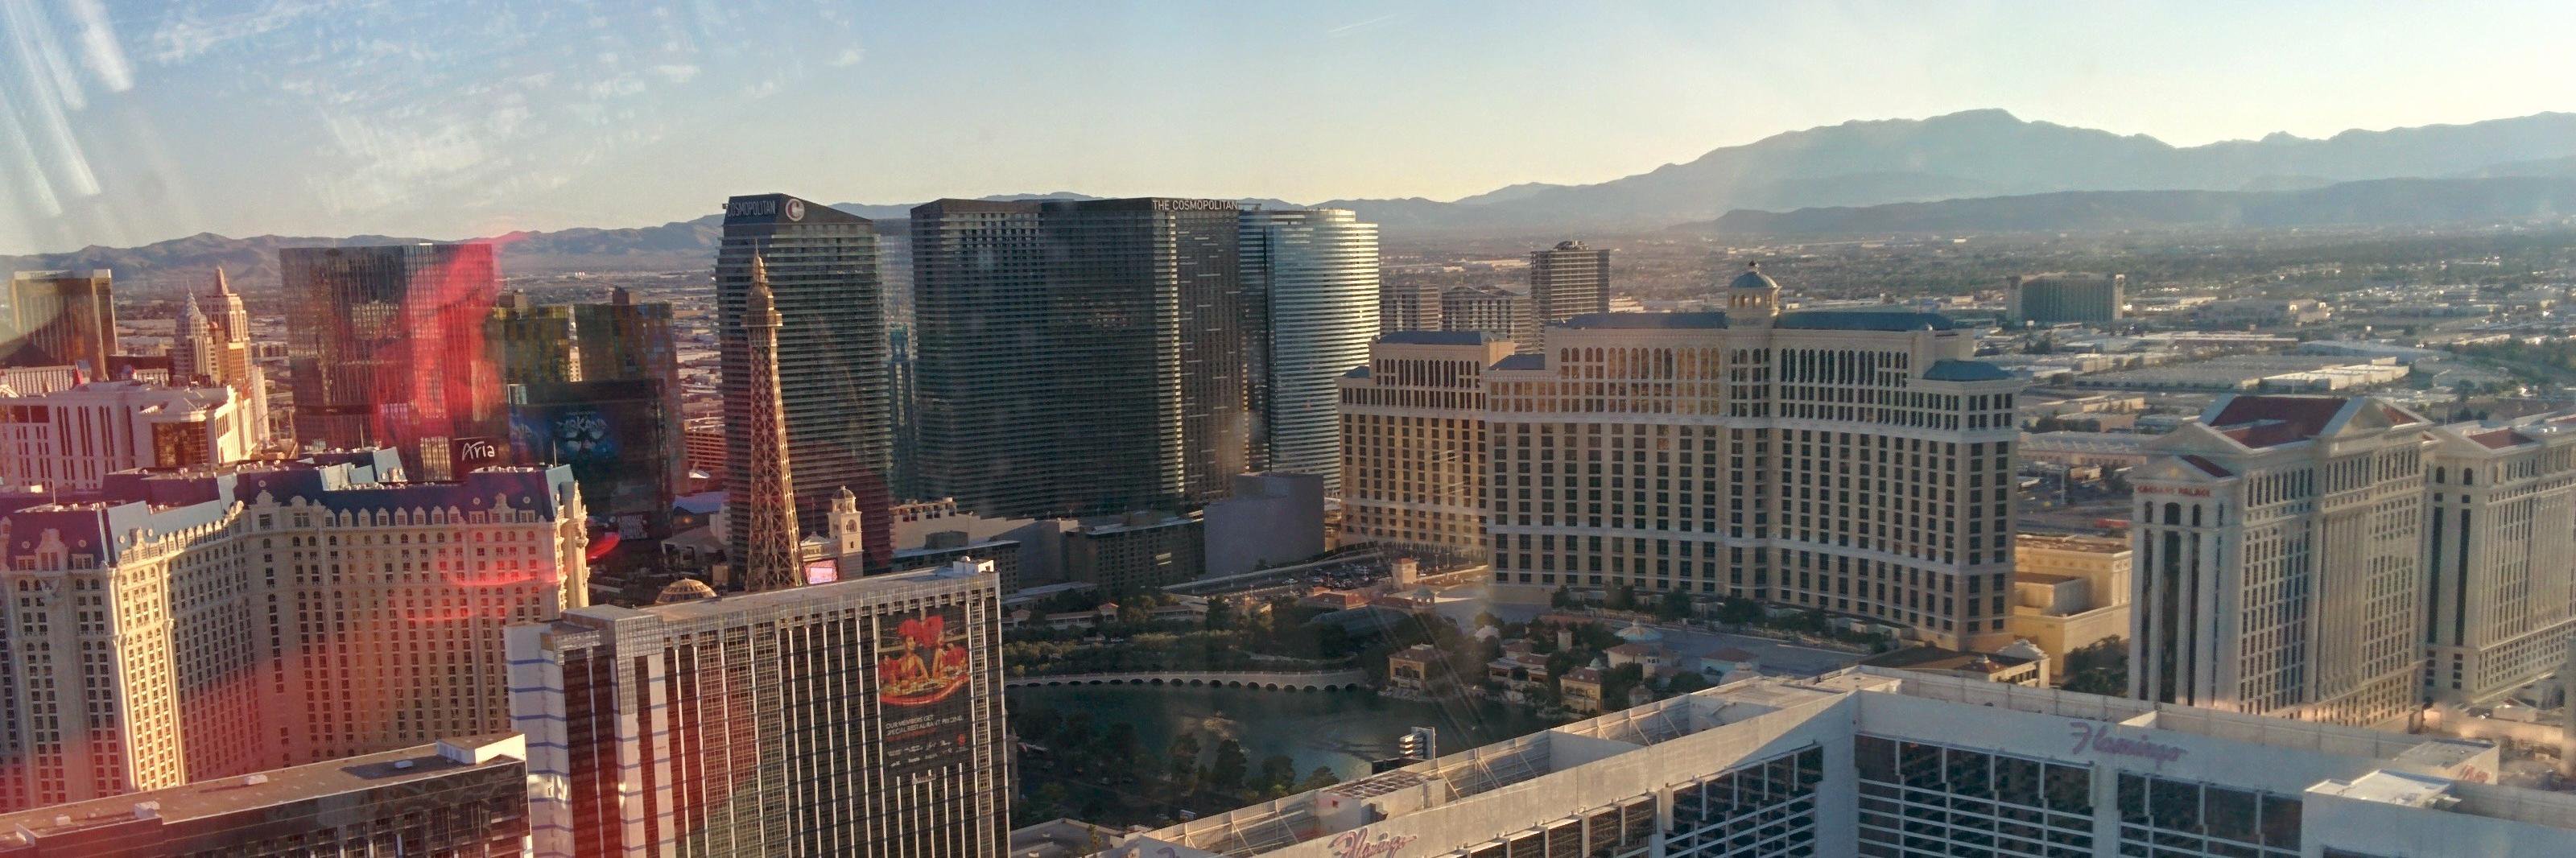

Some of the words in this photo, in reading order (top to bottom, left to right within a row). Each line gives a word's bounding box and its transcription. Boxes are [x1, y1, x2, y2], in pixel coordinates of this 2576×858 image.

[1152, 200, 1170, 210] THE
[1172, 199, 1239, 210] COSMOPOLITAN
[462, 441, 495, 461] Aria
[2070, 721, 2190, 770] Flamingo
